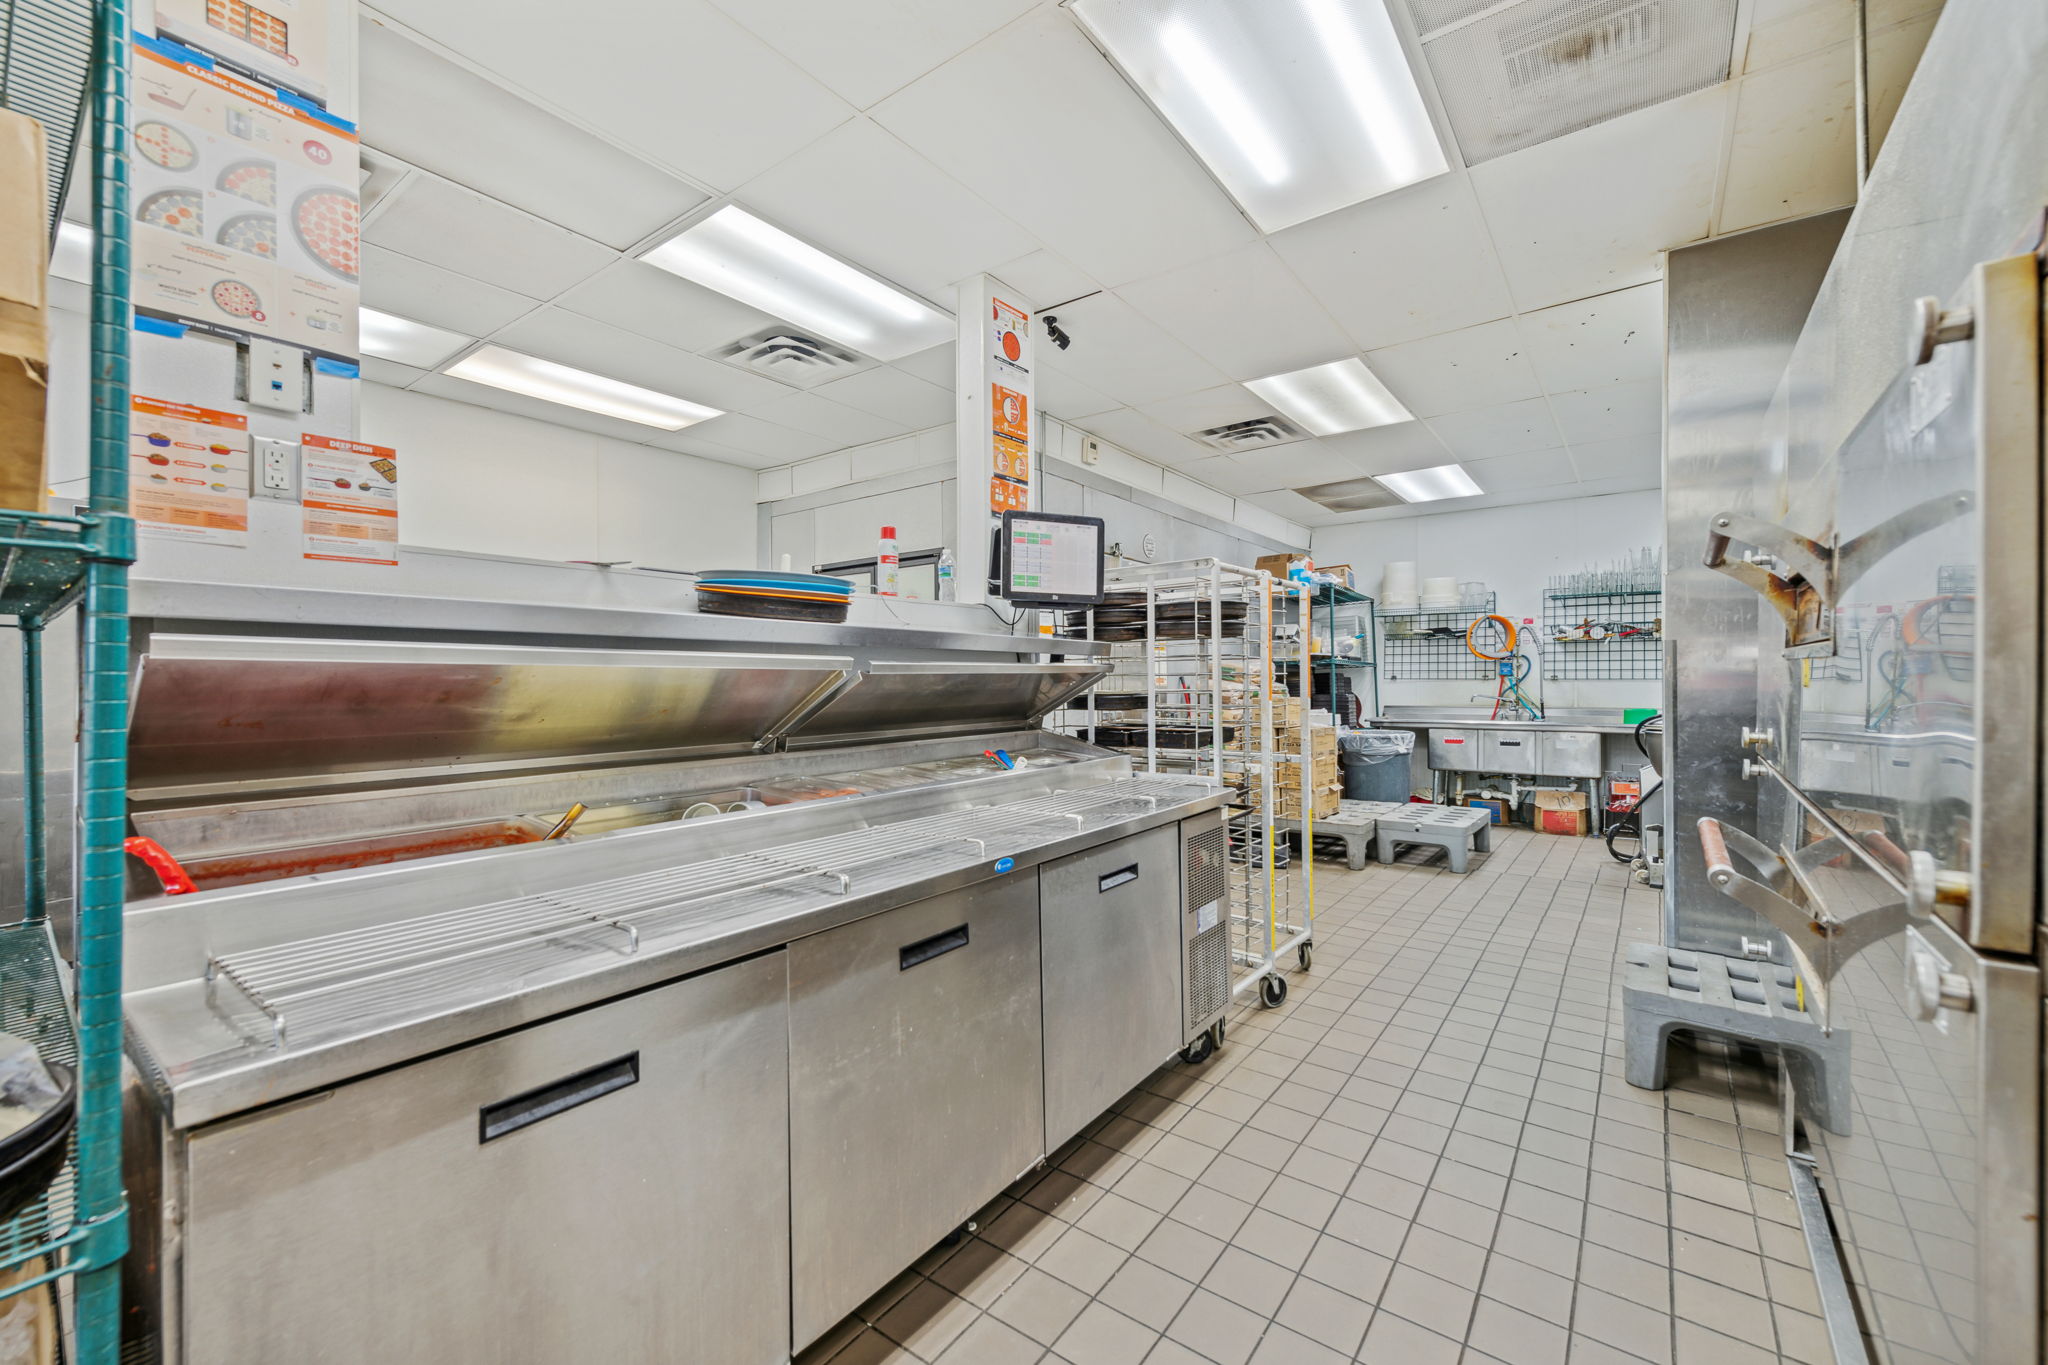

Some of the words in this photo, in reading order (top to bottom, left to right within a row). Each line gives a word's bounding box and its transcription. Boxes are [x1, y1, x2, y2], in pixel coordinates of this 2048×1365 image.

[186, 64, 230, 88] CLASSIC
[229, 82, 266, 103] ROUND
[267, 98, 296, 116] PIZZA
[329, 440, 352, 449] DEEP
[352, 444, 373, 454] DISH
